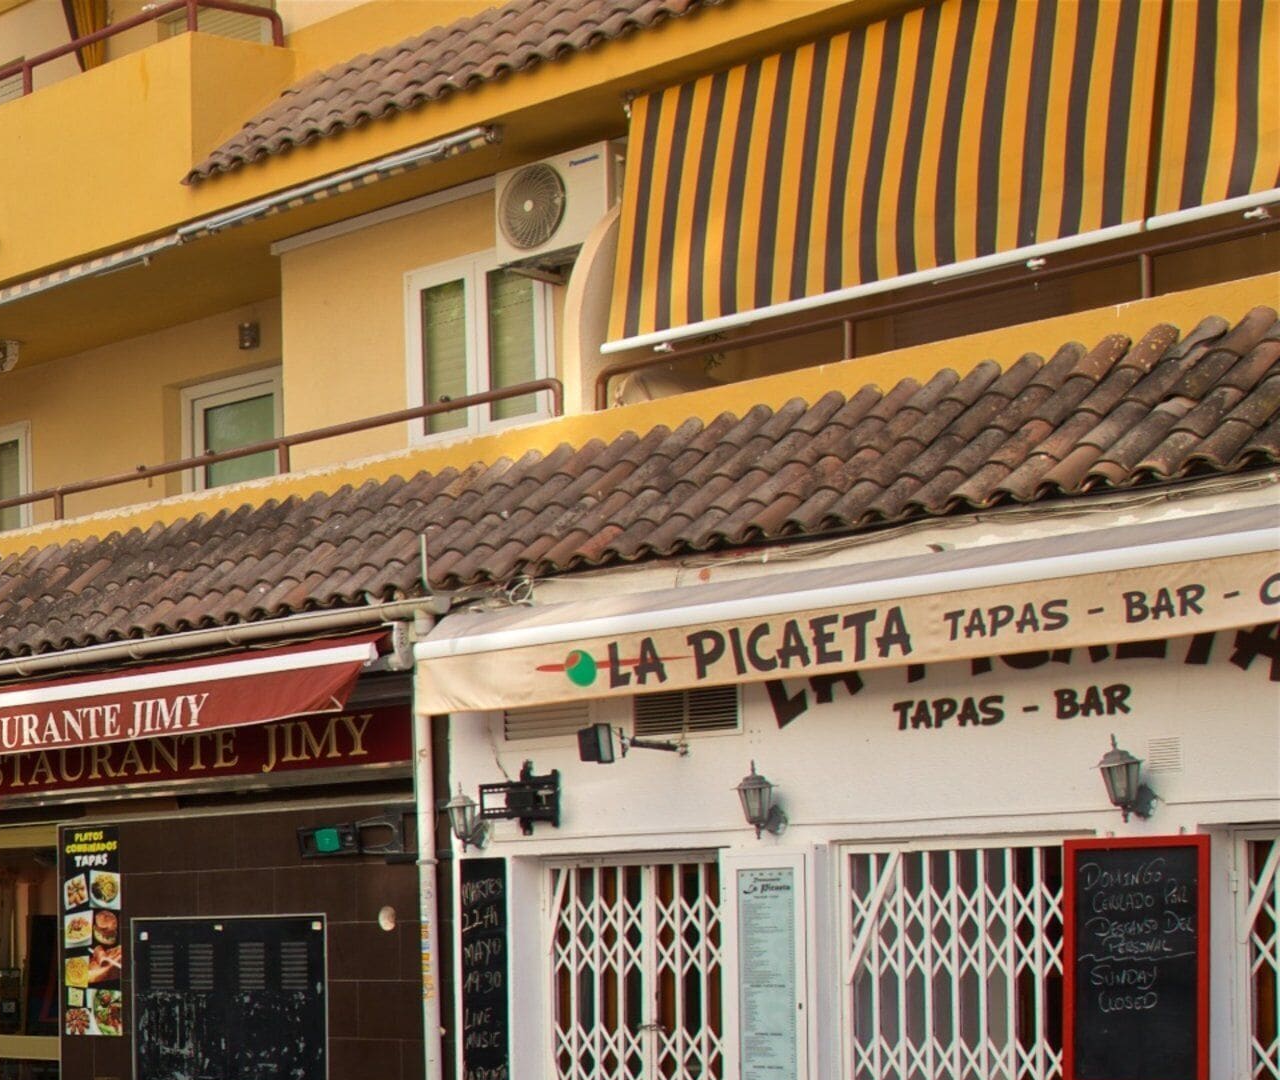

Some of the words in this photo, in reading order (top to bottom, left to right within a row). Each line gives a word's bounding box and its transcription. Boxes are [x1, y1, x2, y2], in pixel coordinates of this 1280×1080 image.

[607, 637, 667, 689] LA
[686, 605, 912, 680] PICAETA
[943, 599, 1069, 641] TAPAS
[1122, 583, 1205, 624] BAR
[127, 692, 209, 739] JIMY
[893, 694, 1004, 730] TAPAS
[1054, 683, 1131, 719] BAR
[262, 714, 373, 773] JIMY
[65, 841, 118, 854] COMBINADOS
[74, 831, 103, 842] PLATOS
[74, 853, 108, 867] TAPAS
[464, 938, 501, 966] MAYO
[1090, 964, 1158, 990] SUNDAY
[1098, 991, 1158, 1013] CLOSED
[464, 1007, 493, 1030] LIVE
[465, 1031, 501, 1050] MUSIC
